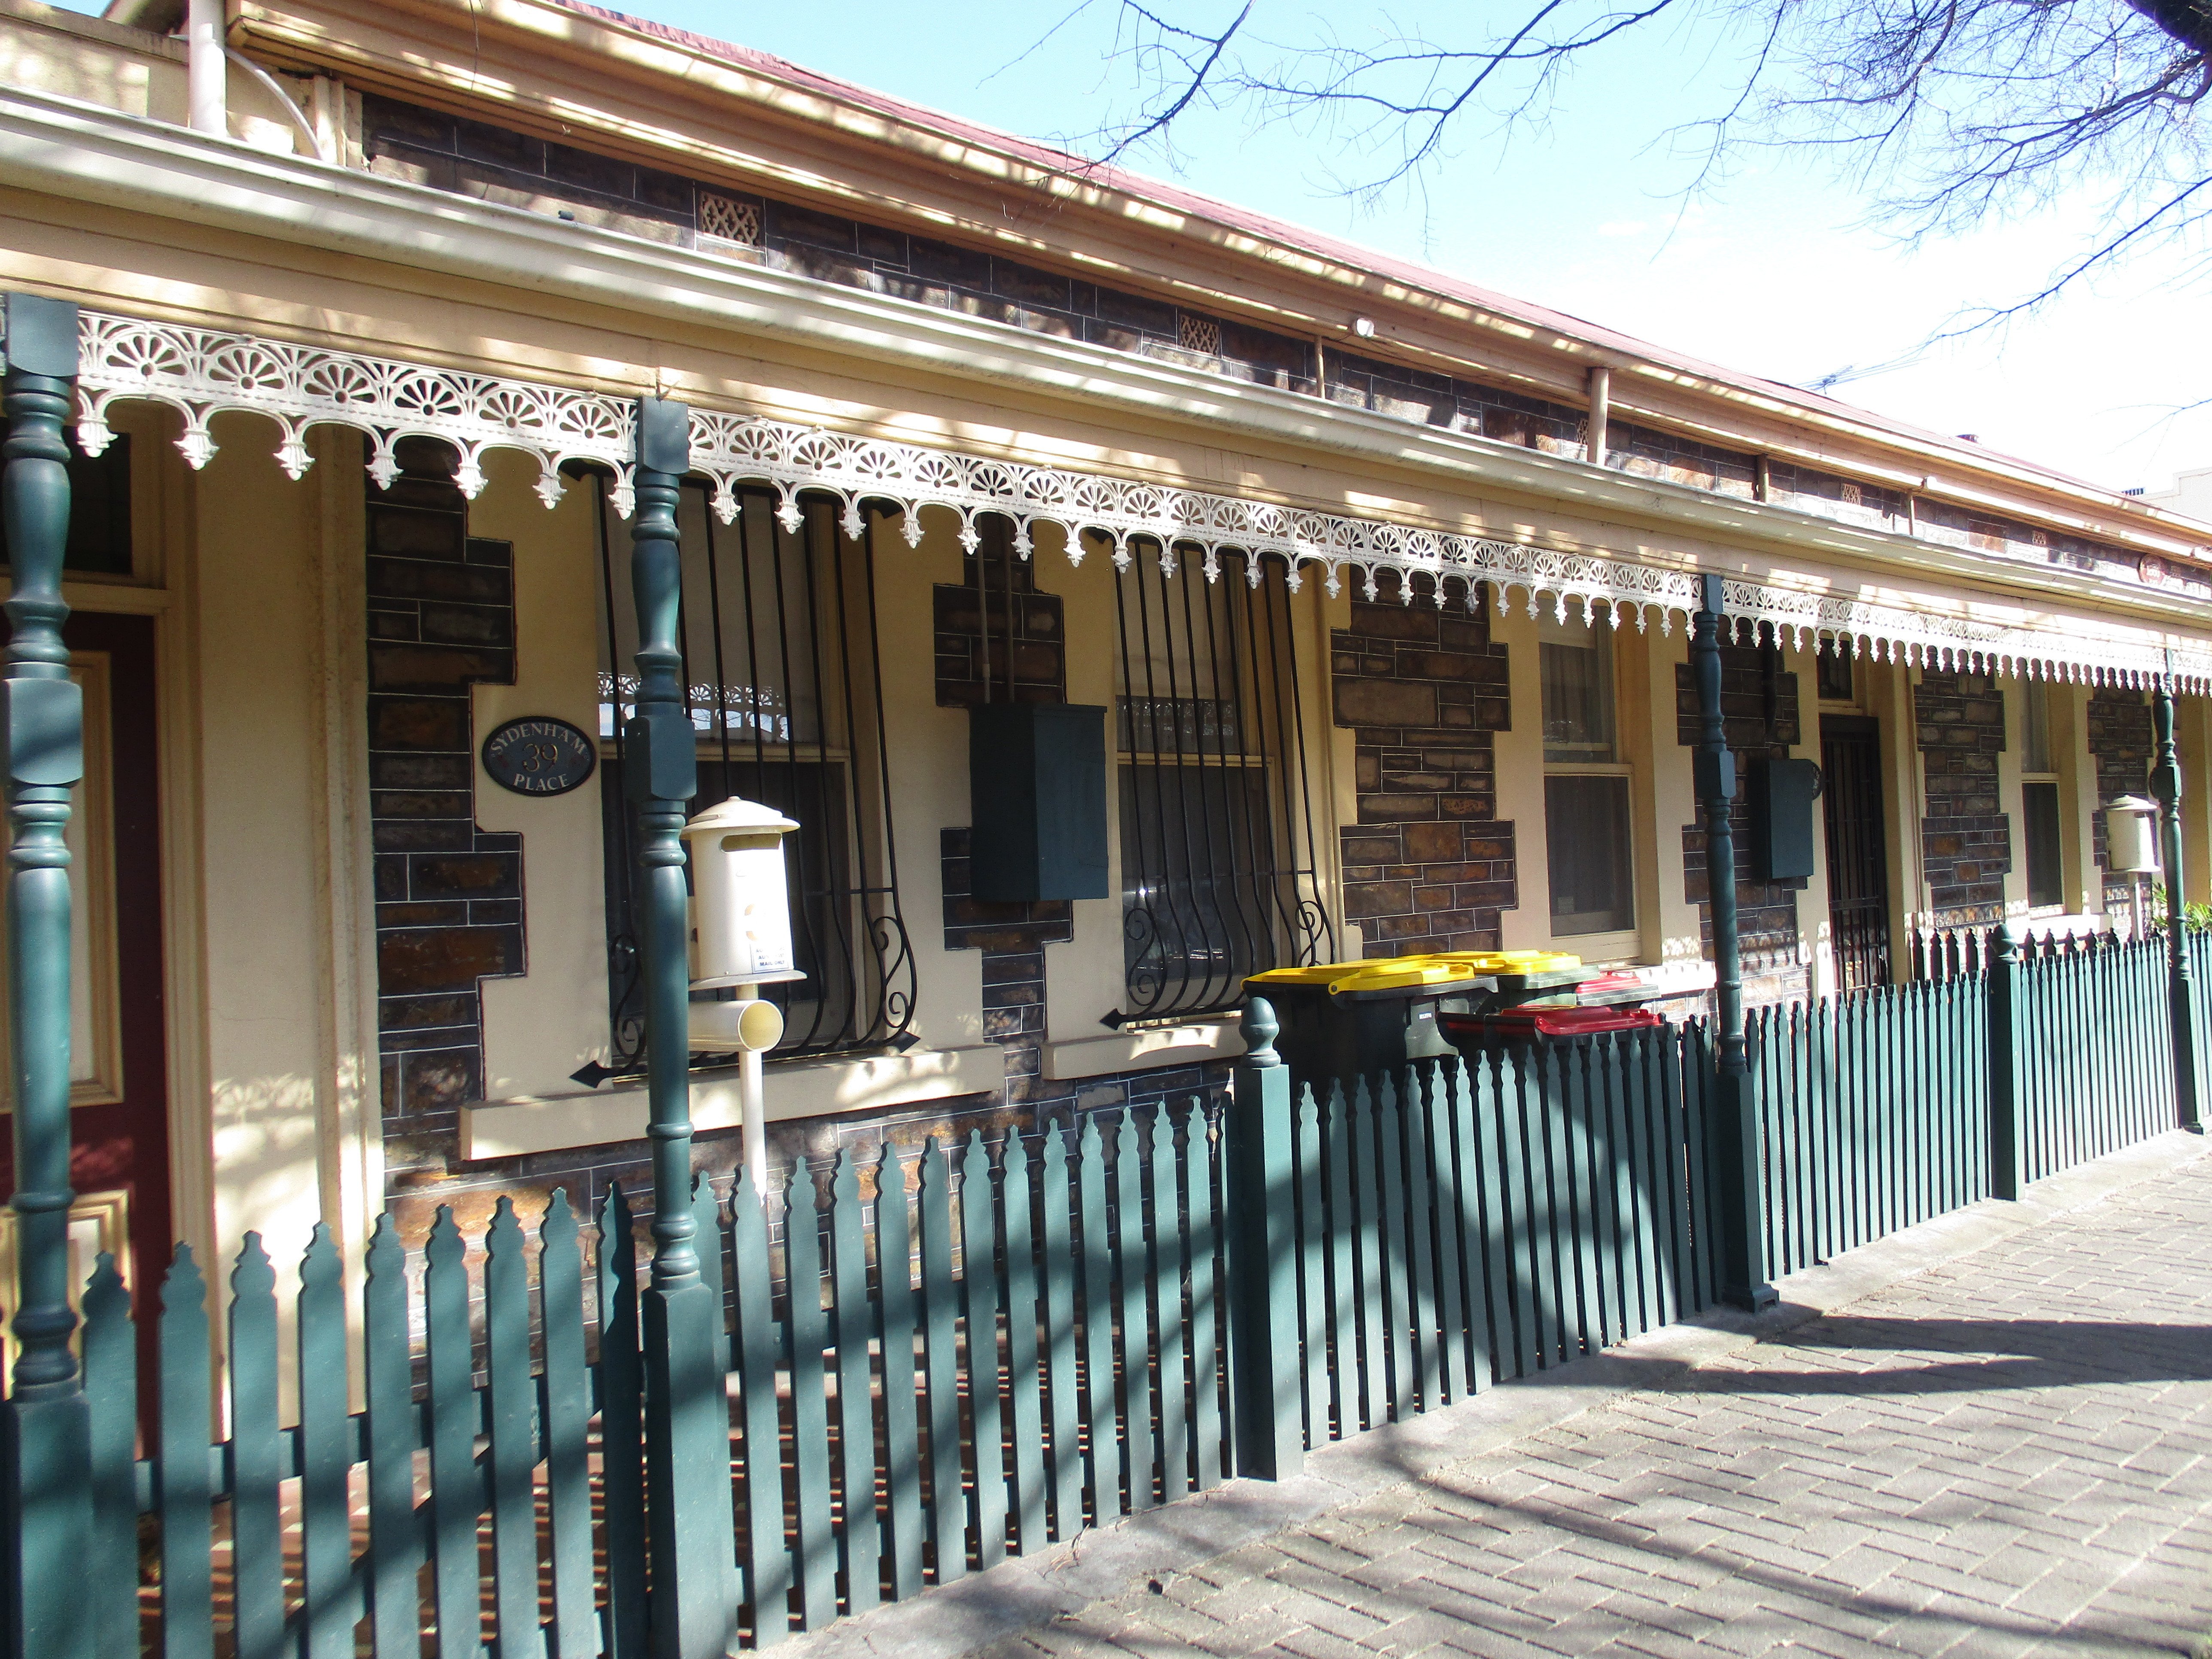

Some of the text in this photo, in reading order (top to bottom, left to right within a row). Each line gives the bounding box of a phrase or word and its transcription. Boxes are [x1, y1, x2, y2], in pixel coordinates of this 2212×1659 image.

[490, 723, 588, 757] SYDENHAM
[523, 743, 558, 772] 39
[513, 773, 570, 791] PLACE
